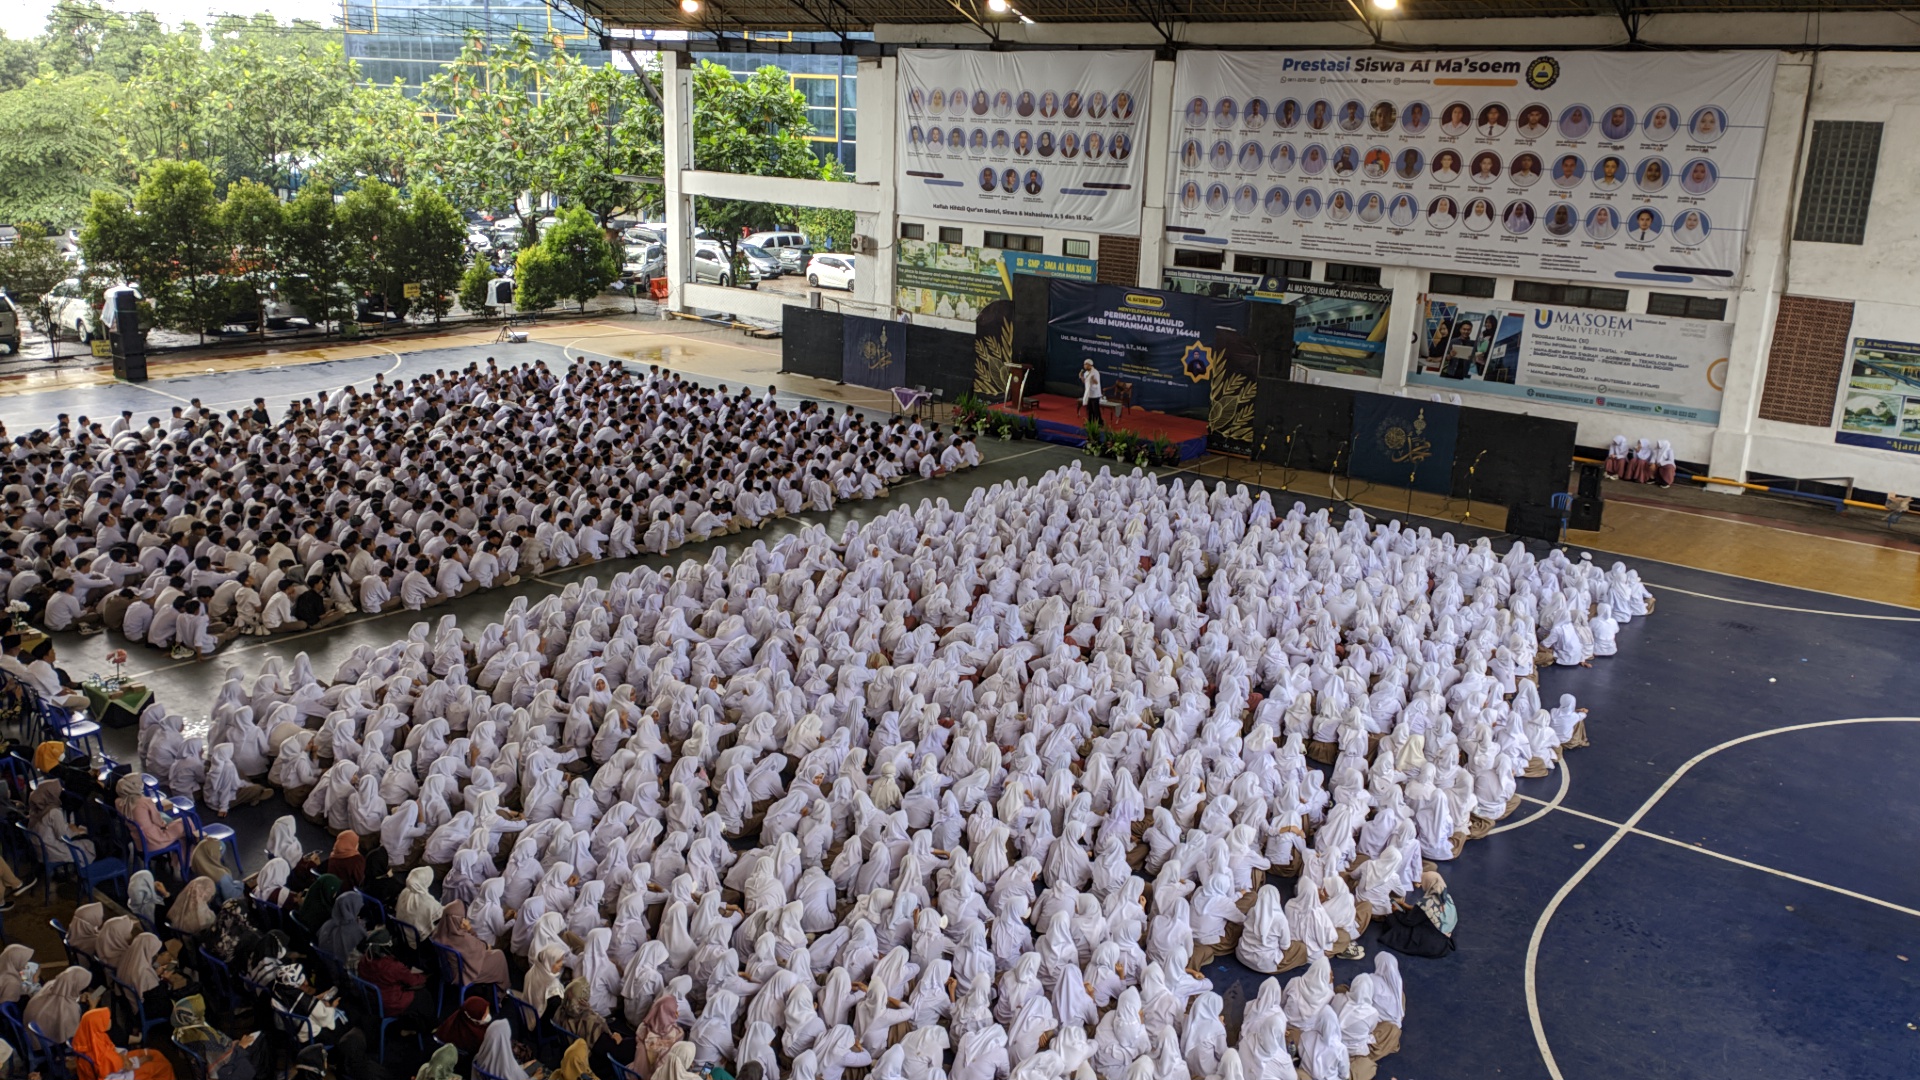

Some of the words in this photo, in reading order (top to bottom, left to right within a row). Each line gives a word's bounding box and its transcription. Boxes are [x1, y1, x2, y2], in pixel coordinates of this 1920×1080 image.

[1282, 56, 1351, 72] Prestasi
[1354, 57, 1405, 72] Siswa
[1410, 59, 1431, 72] Al
[1435, 58, 1521, 73] Ma'soem
[966, 206, 984, 214] Qur'an
[1016, 258, 1024, 266] SD
[1028, 258, 1040, 268] SMP
[1044, 261, 1056, 270] SMA
[1058, 262, 1064, 272] AL
[1066, 263, 1092, 274] MA'SOEM
[1287, 283, 1294, 292] AL
[1294, 284, 1318, 294] MA'SOEM
[1318, 287, 1339, 297] ISLAMIC
[1340, 289, 1368, 300] BOARDING
[1088, 316, 1106, 327] NABI
[1108, 319, 1154, 332] MUHAMMAD
[1156, 325, 1174, 335] SAW
[1176, 328, 1200, 338] 1444H
[1104, 310, 1152, 323] PERINGATAN
[1154, 316, 1184, 328] MAULID
[1554, 311, 1633, 330] MA'SOEM
[1560, 324, 1625, 338] UNIVERSITY
[1097, 346, 1110, 354] Kang
